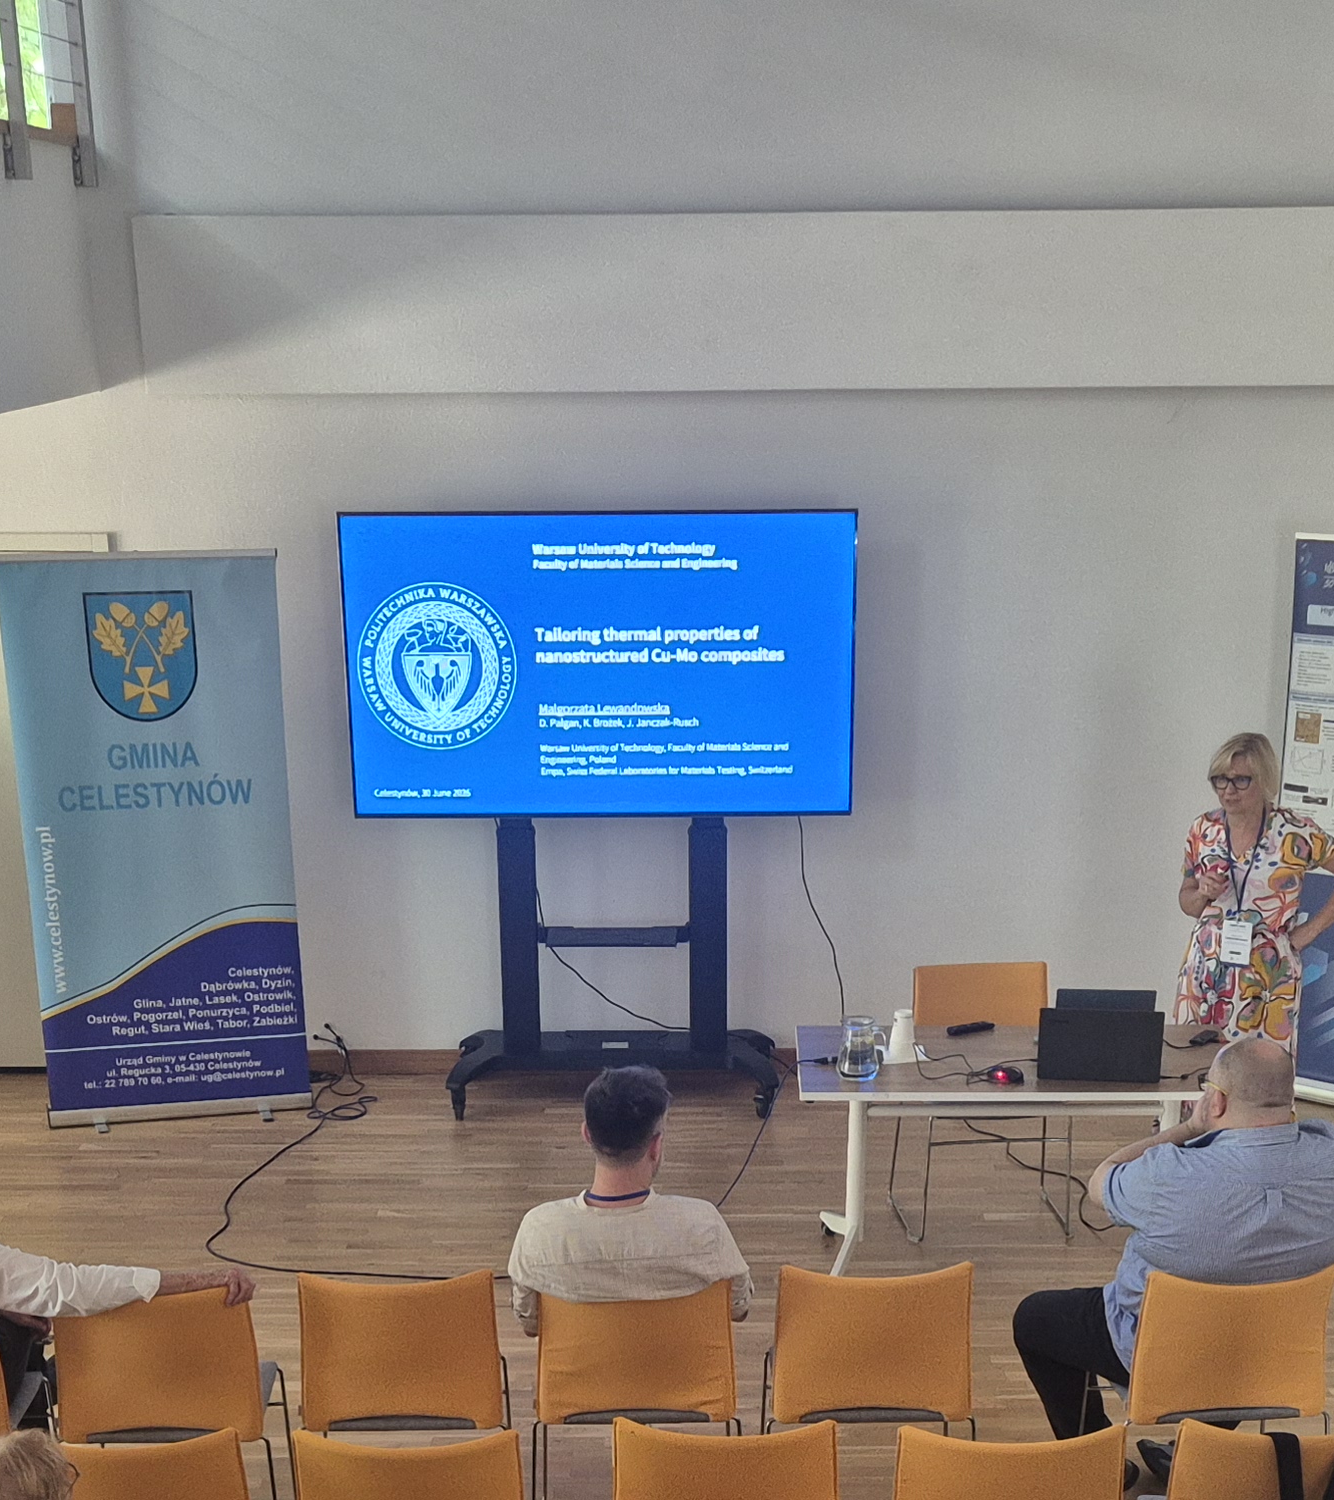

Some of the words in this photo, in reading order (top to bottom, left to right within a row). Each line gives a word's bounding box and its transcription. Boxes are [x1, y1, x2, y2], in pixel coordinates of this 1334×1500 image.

[578, 543, 635, 557] University
[637, 542, 650, 555] of
[650, 542, 716, 557] Technology
[569, 559, 579, 569] of
[364, 587, 436, 648] POLITECHNIKA
[438, 587, 508, 649] WARSZAWSKA
[534, 626, 601, 645] Tailoring
[603, 626, 662, 642] thermal
[664, 626, 740, 644] properties
[742, 625, 759, 641] of
[535, 647, 649, 664] nanostructured
[651, 648, 698, 663] Cu-Mo
[700, 647, 785, 665] composites
[362, 656, 387, 712] WARSAW
[384, 711, 452, 744] UNIVERSITY
[456, 731, 472, 743] OF
[471, 656, 512, 733] TECHNOLOGY
[106, 741, 200, 771] GMINA
[58, 773, 253, 813] CELESTYNÓW
[35, 825, 67, 994] www.celestynow.pl
[146, 1055, 176, 1066] Gminy
[120, 1066, 162, 1078] Regucka
[104, 1079, 116, 1089] 22
